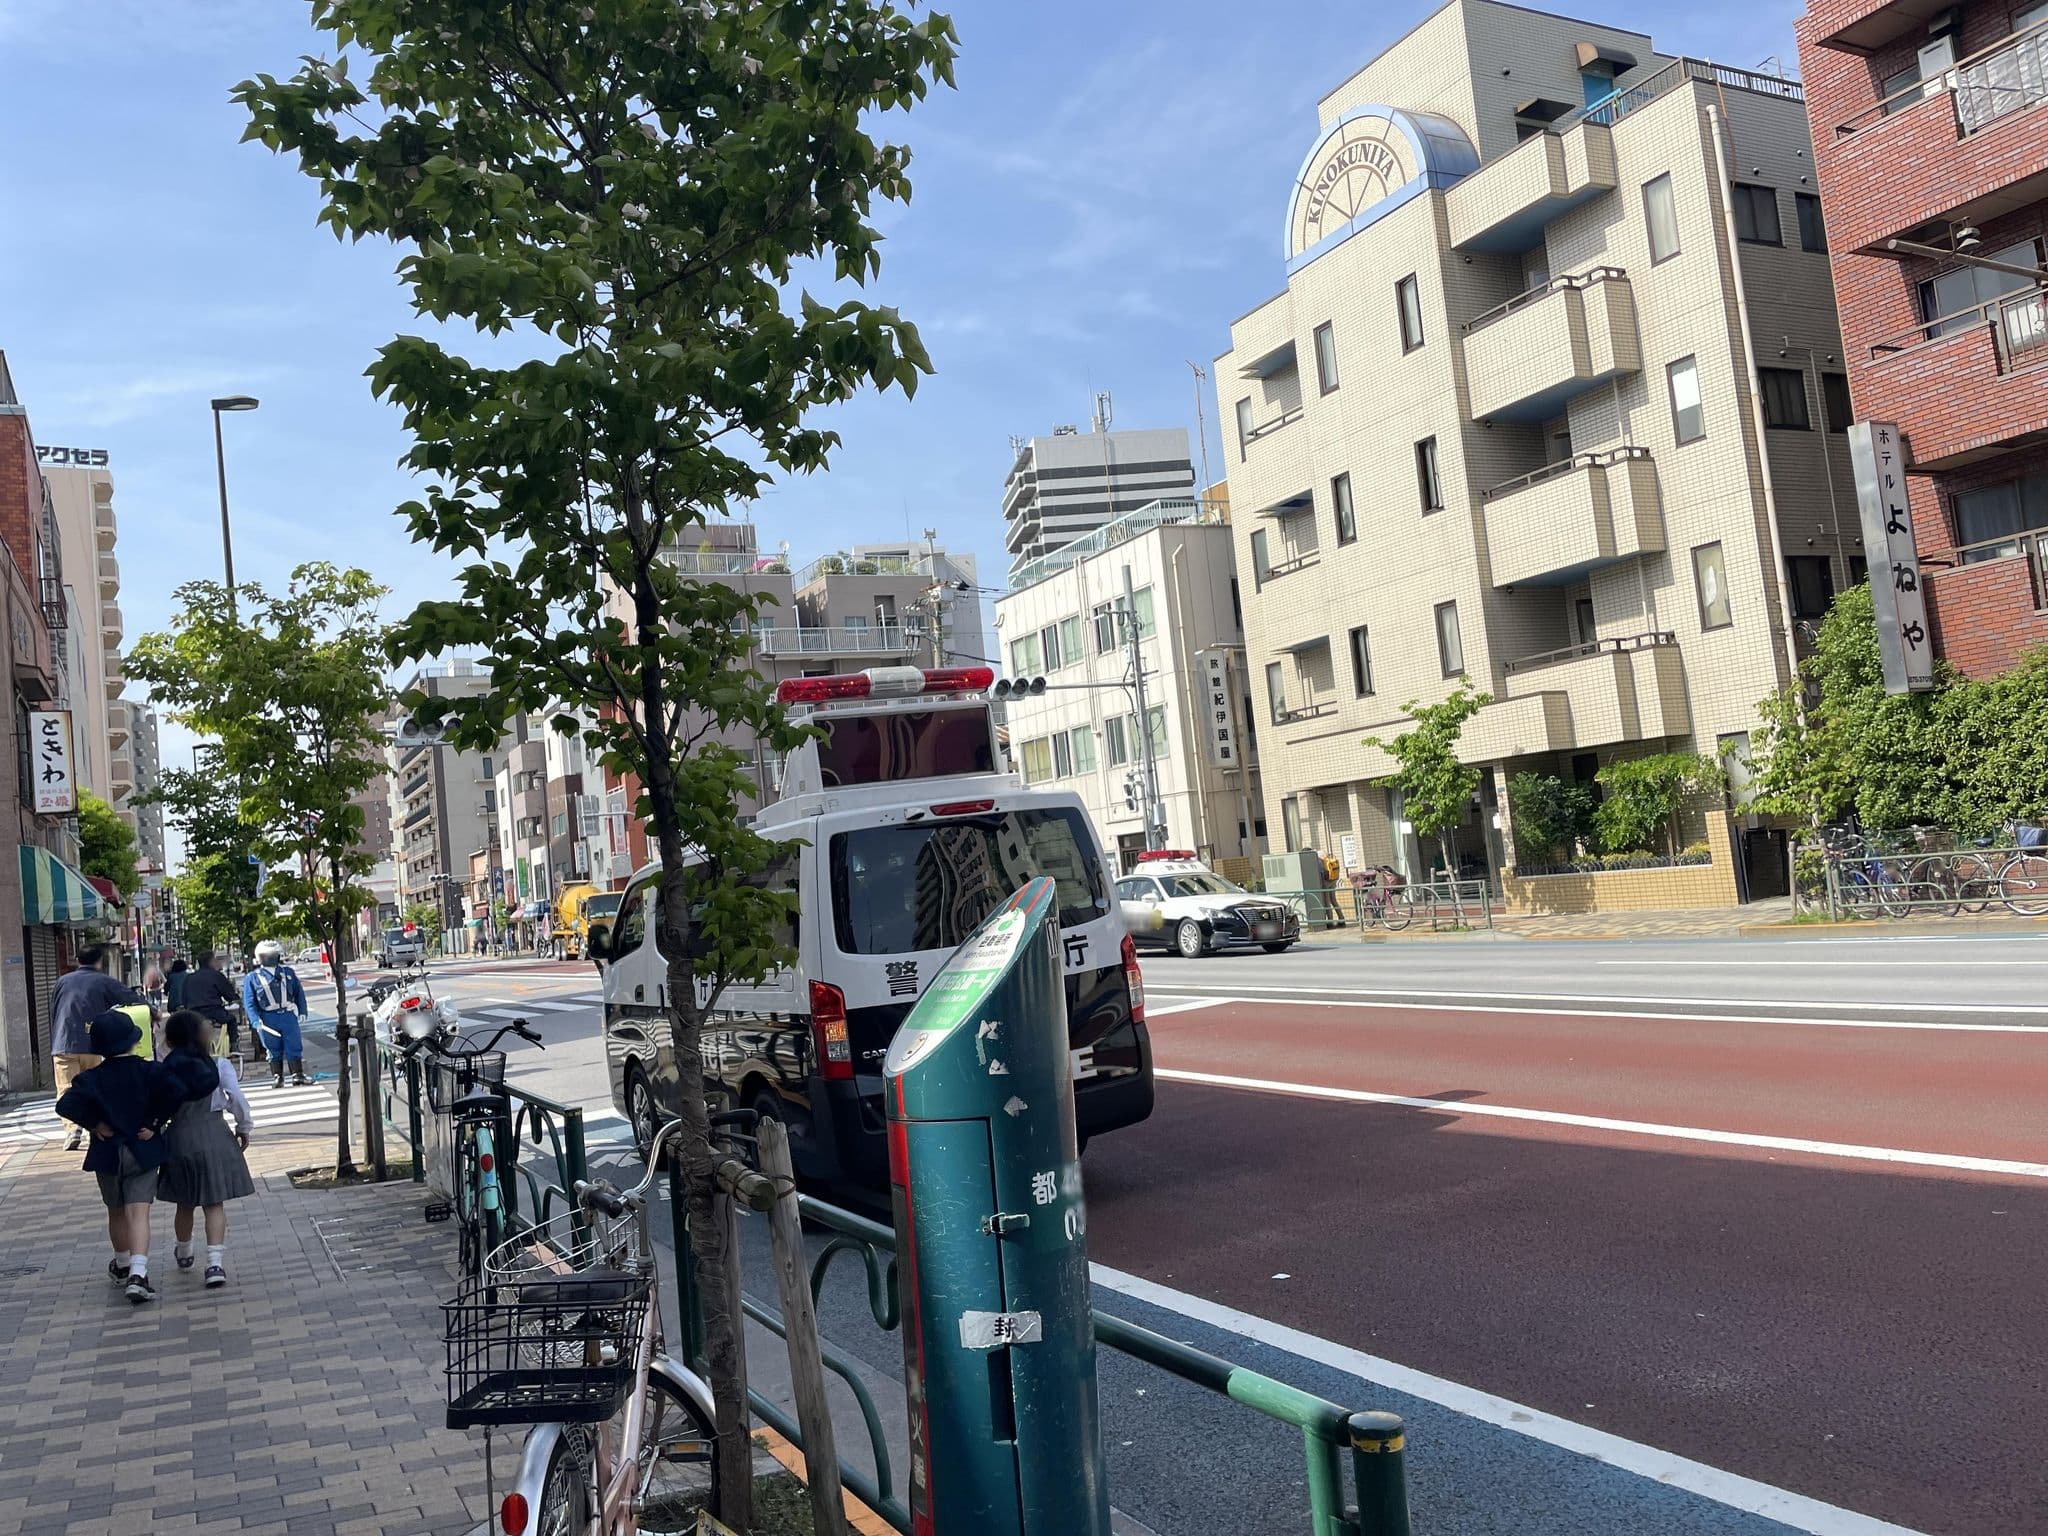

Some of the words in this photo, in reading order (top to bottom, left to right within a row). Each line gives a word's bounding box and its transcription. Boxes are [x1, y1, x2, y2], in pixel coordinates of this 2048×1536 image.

[1308, 143, 1394, 224] KINOKUNIYA
[1878, 429, 1896, 490] ホテル
[1886, 503, 1925, 652] よねや
[41, 718, 66, 784] ときわ
[885, 960, 919, 997] 警
[1063, 933, 1089, 968] 庁
[1031, 1170, 1057, 1206] 都
[994, 1316, 1018, 1338] 封
